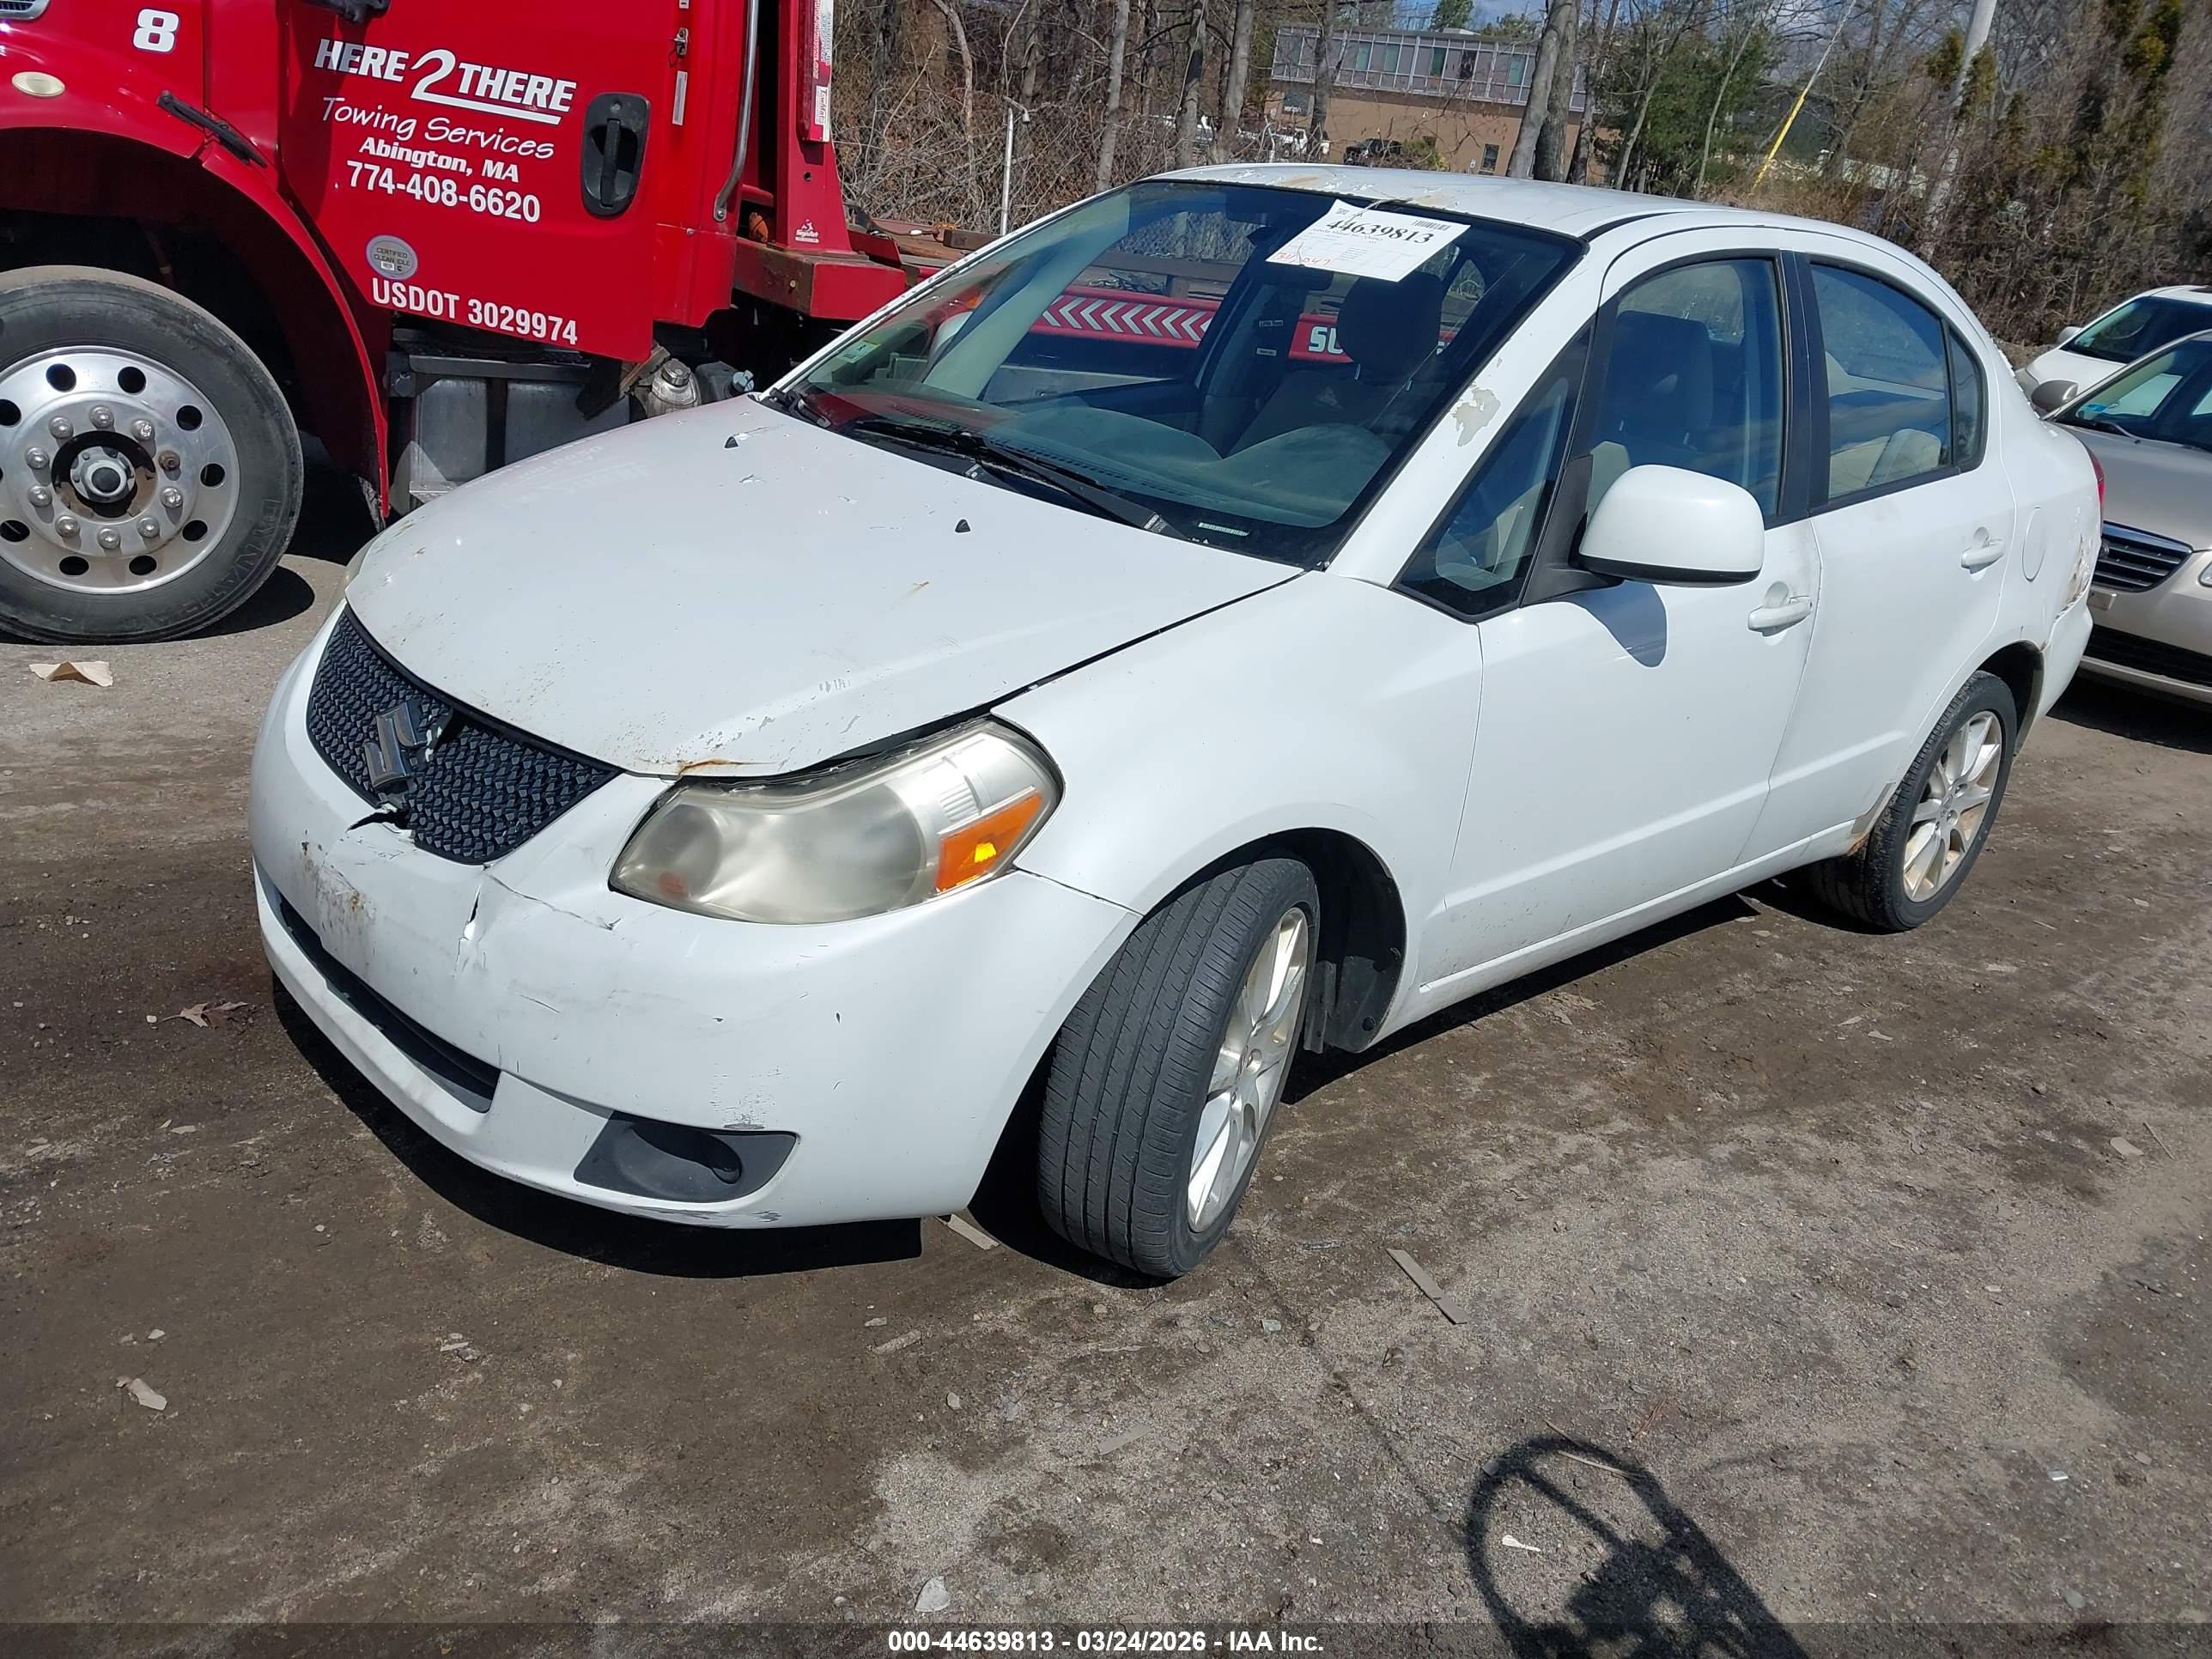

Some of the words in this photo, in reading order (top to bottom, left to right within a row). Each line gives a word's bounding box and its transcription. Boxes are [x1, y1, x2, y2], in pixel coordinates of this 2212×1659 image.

[133, 9, 179, 52] 8
[314, 39, 409, 82] HERE
[410, 49, 457, 100] 2
[458, 63, 577, 112] THERE
[323, 97, 416, 140] Towing
[424, 118, 555, 159] Services
[347, 160, 540, 222] 774-408-6620
[359, 137, 472, 176] Abington,
[482, 160, 520, 183] MA
[1326, 220, 1435, 244] 44639813
[373, 277, 460, 319] USDOT
[468, 299, 578, 345] 3029974
